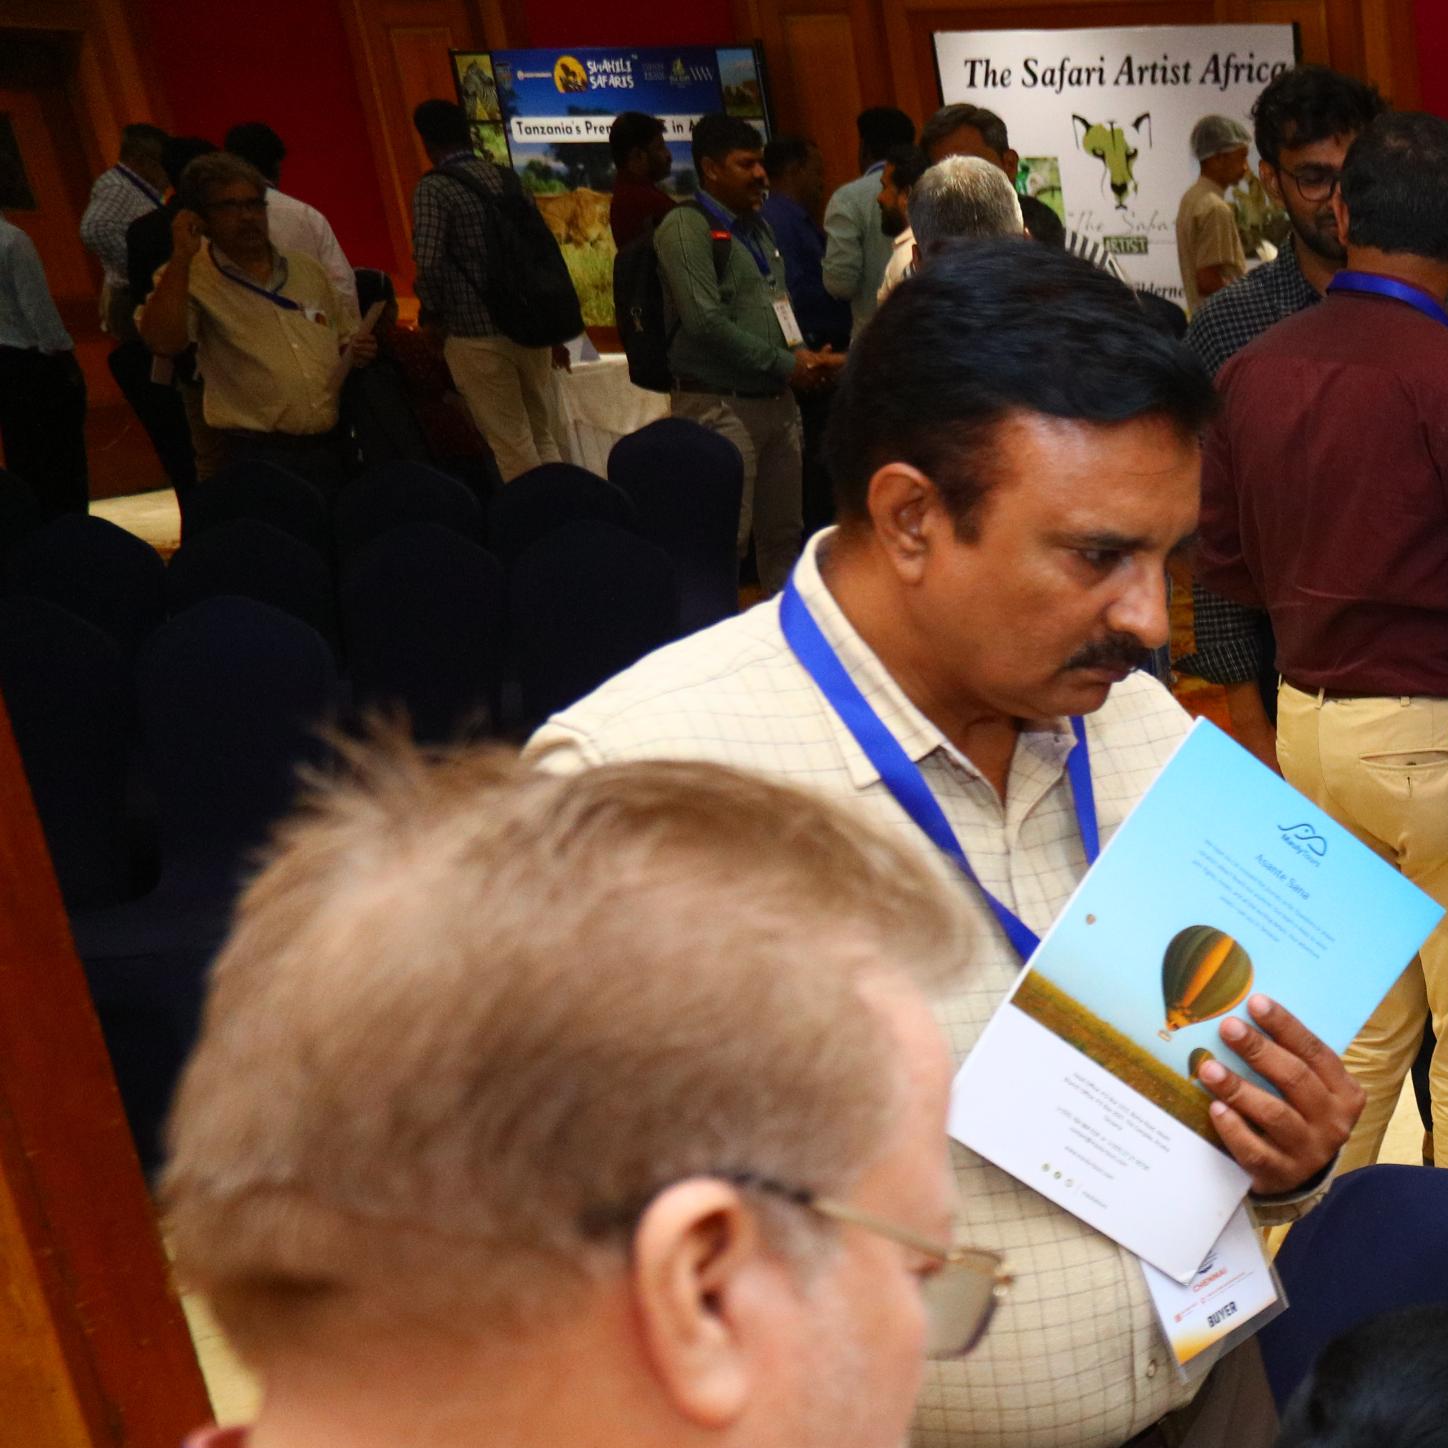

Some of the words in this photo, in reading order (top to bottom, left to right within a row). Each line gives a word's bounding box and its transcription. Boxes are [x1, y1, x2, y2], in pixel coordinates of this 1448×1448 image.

[588, 74, 635, 90] SAFARIS
[963, 57, 1012, 89] The
[1021, 56, 1104, 95] Safari
[1113, 53, 1192, 86] Artist
[1200, 52, 1288, 92] Africa
[516, 121, 582, 136] Tanzania's
[671, 119, 684, 133] in
[1254, 853, 1287, 881] Asante
[1288, 877, 1311, 901] Sana
[1206, 1300, 1238, 1328] BUYER
